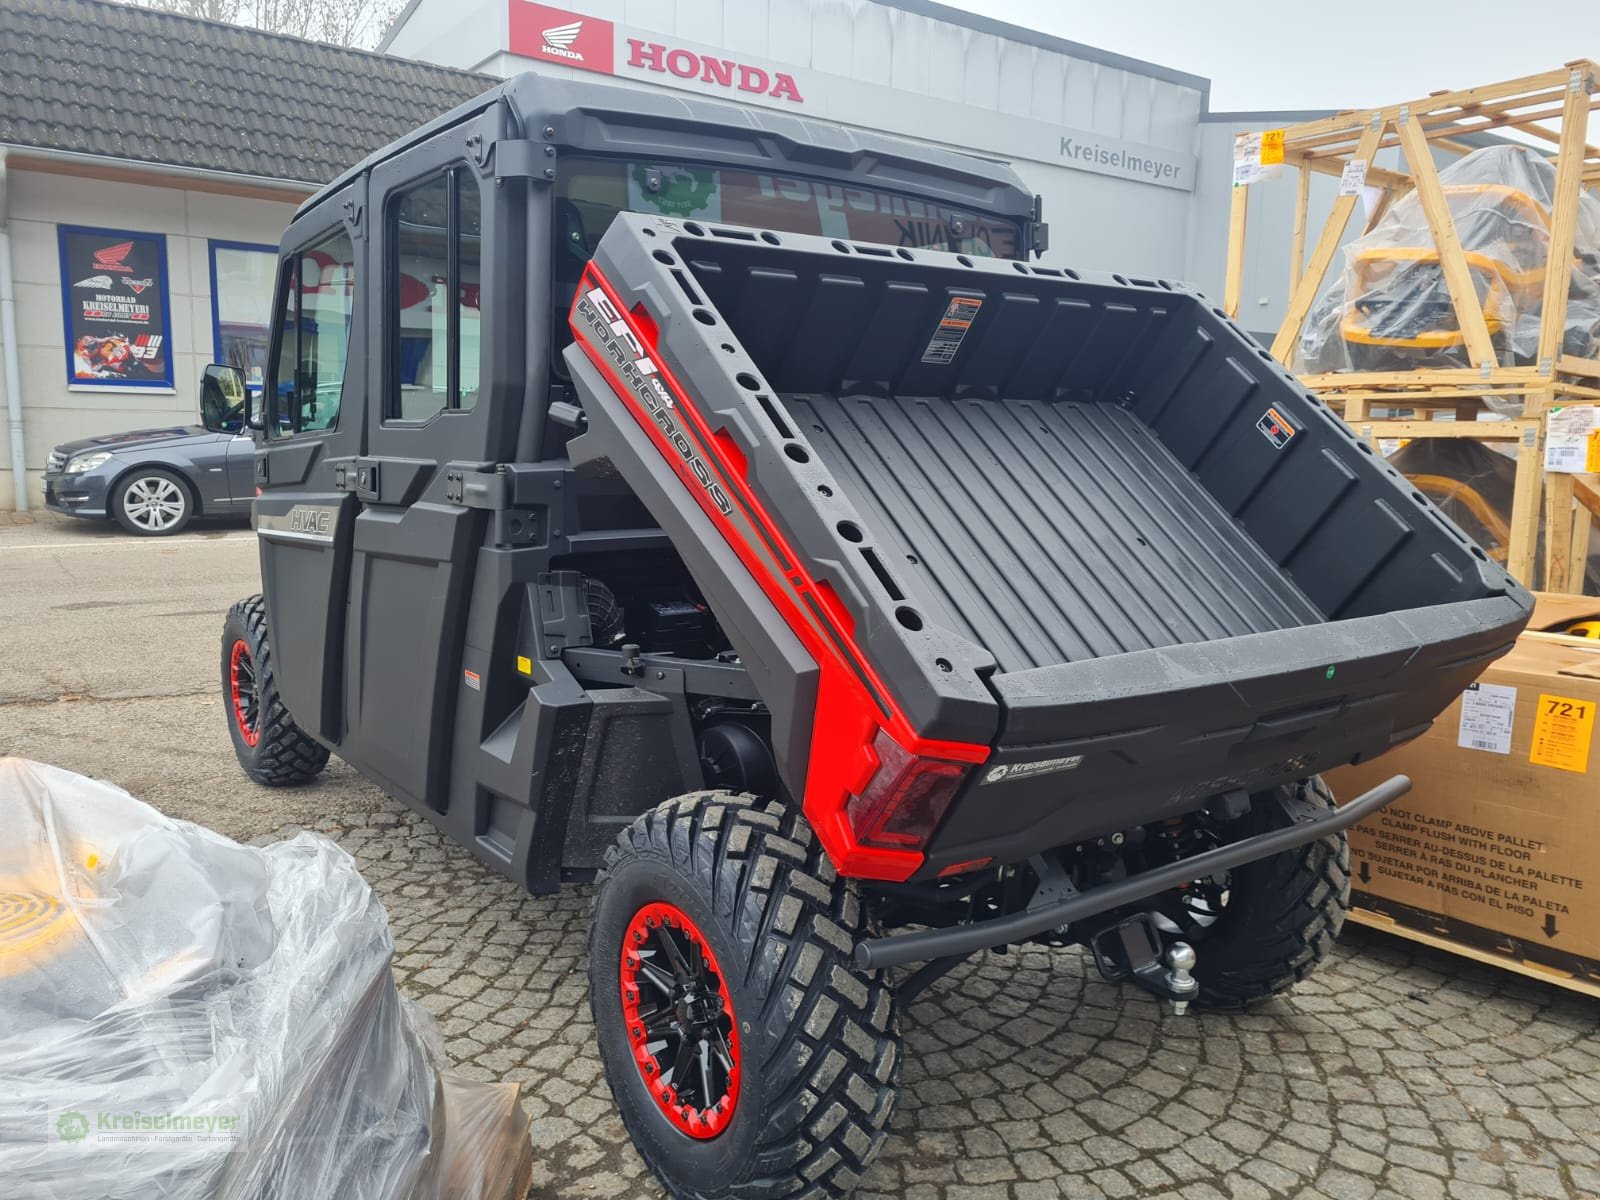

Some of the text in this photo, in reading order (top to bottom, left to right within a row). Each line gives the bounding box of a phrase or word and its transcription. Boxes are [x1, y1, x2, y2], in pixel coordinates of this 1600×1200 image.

[541, 45, 584, 61] HONDA
[627, 38, 804, 103] HONDA
[1060, 137, 1181, 178] Kreiselmeyer
[95, 294, 137, 304] MOTORRAD
[290, 510, 331, 533] HVAC
[1547, 700, 1586, 719] 721
[1381, 817, 1531, 861] CLAMP FLUSH WITH FLOOR
[1390, 808, 1411, 819] NOT
[1414, 814, 1453, 829] CLAMP
[1454, 824, 1494, 840] ABOVE
[1497, 833, 1544, 851] PALLET
[1356, 825, 1376, 836] PAS
[1378, 830, 1421, 848] SERRER
[1424, 842, 1487, 866] AU-DESSUS
[1490, 859, 1505, 871] DE
[1509, 864, 1524, 875] LA
[1528, 868, 1583, 890] PALETTE
[1375, 840, 1417, 858] SERRER
[1430, 856, 1453, 868] RAS
[1456, 862, 1471, 873] DU
[1474, 867, 1538, 891] PLANCHER
[1367, 851, 1413, 871] SUJETAR
[1416, 865, 1439, 879] POR
[1441, 872, 1482, 891] ARRIBA
[1485, 885, 1502, 897] DE
[1504, 890, 1520, 902] LA
[1522, 895, 1570, 914] PALETA
[1377, 865, 1424, 885] SUJETAR
[1436, 882, 1459, 896] RAS
[1461, 890, 1486, 904] CON
[1489, 898, 1503, 909] EL
[1506, 902, 1535, 917] PISO
